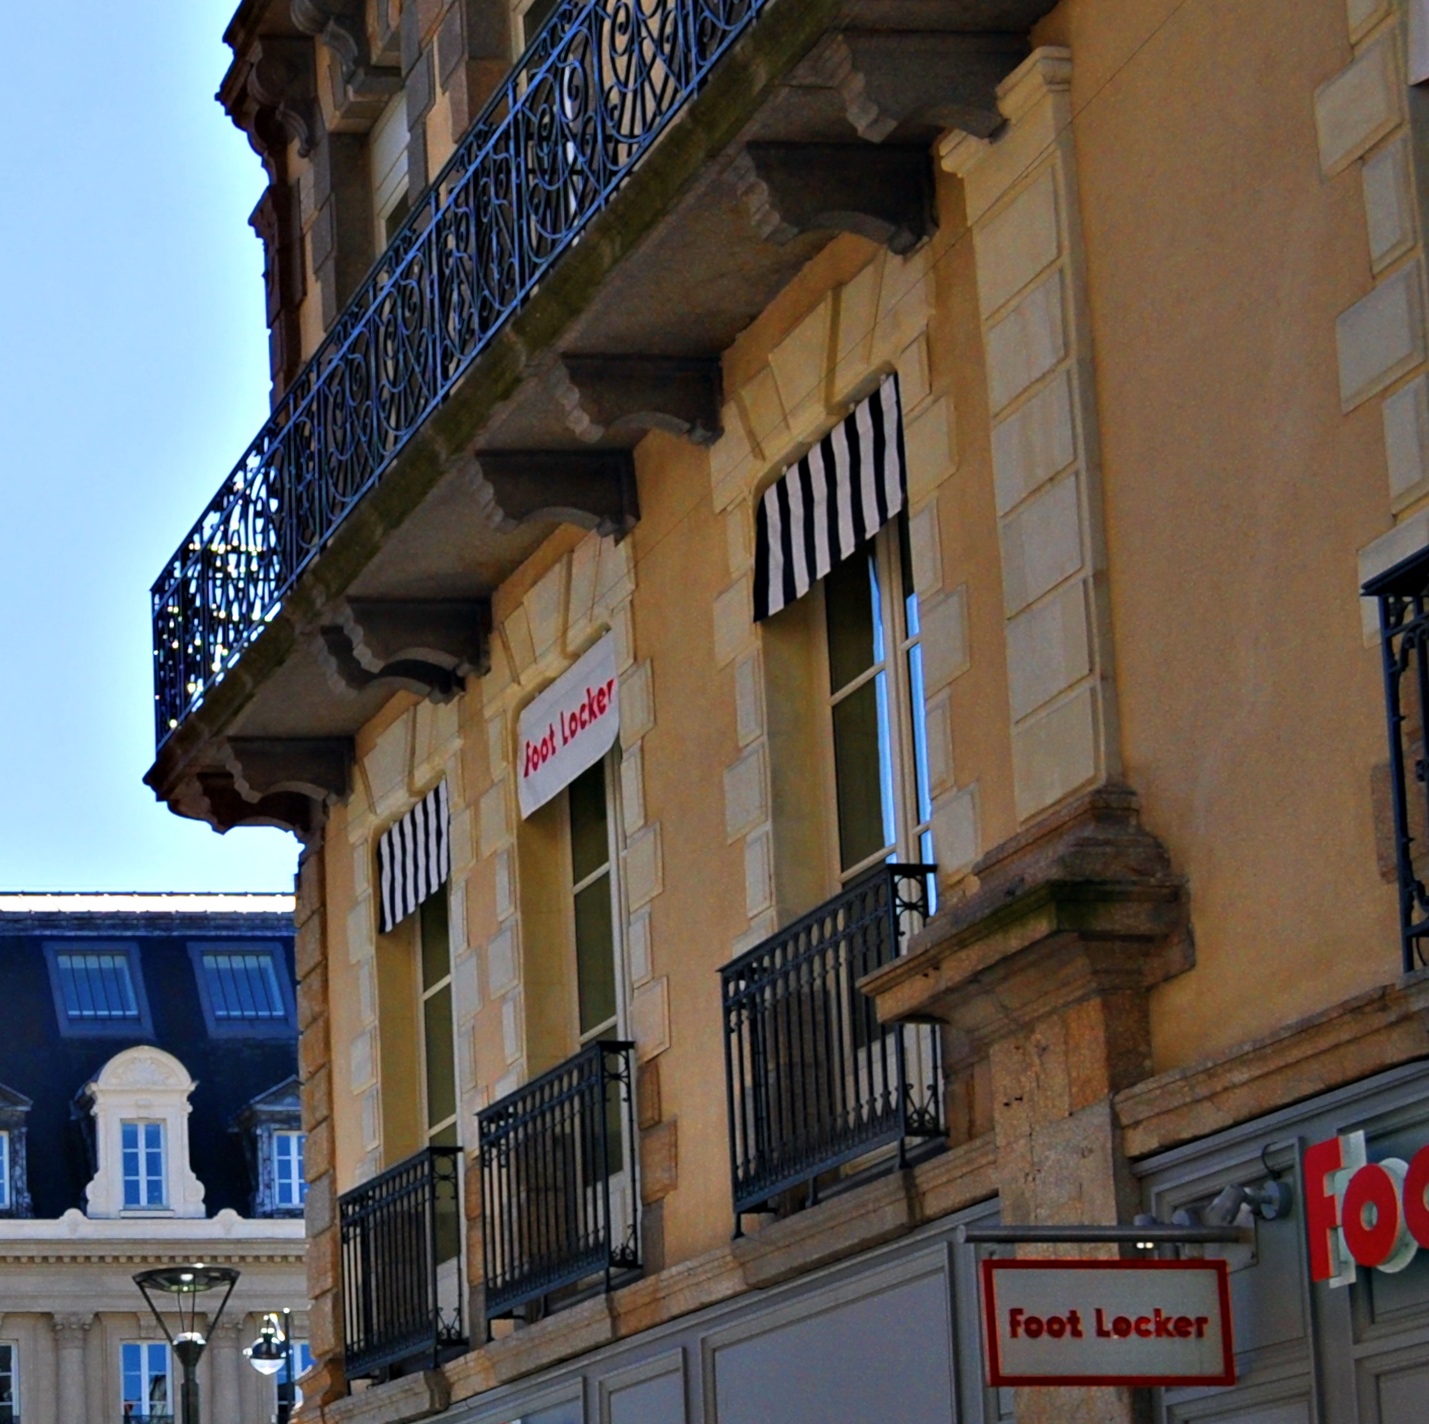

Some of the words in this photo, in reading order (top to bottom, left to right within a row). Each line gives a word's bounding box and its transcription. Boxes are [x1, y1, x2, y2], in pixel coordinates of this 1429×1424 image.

[524, 723, 556, 778] Foot
[560, 678, 614, 747] Locker
[1009, 1307, 1083, 1340] Foot
[1094, 1307, 1209, 1340] Locker
